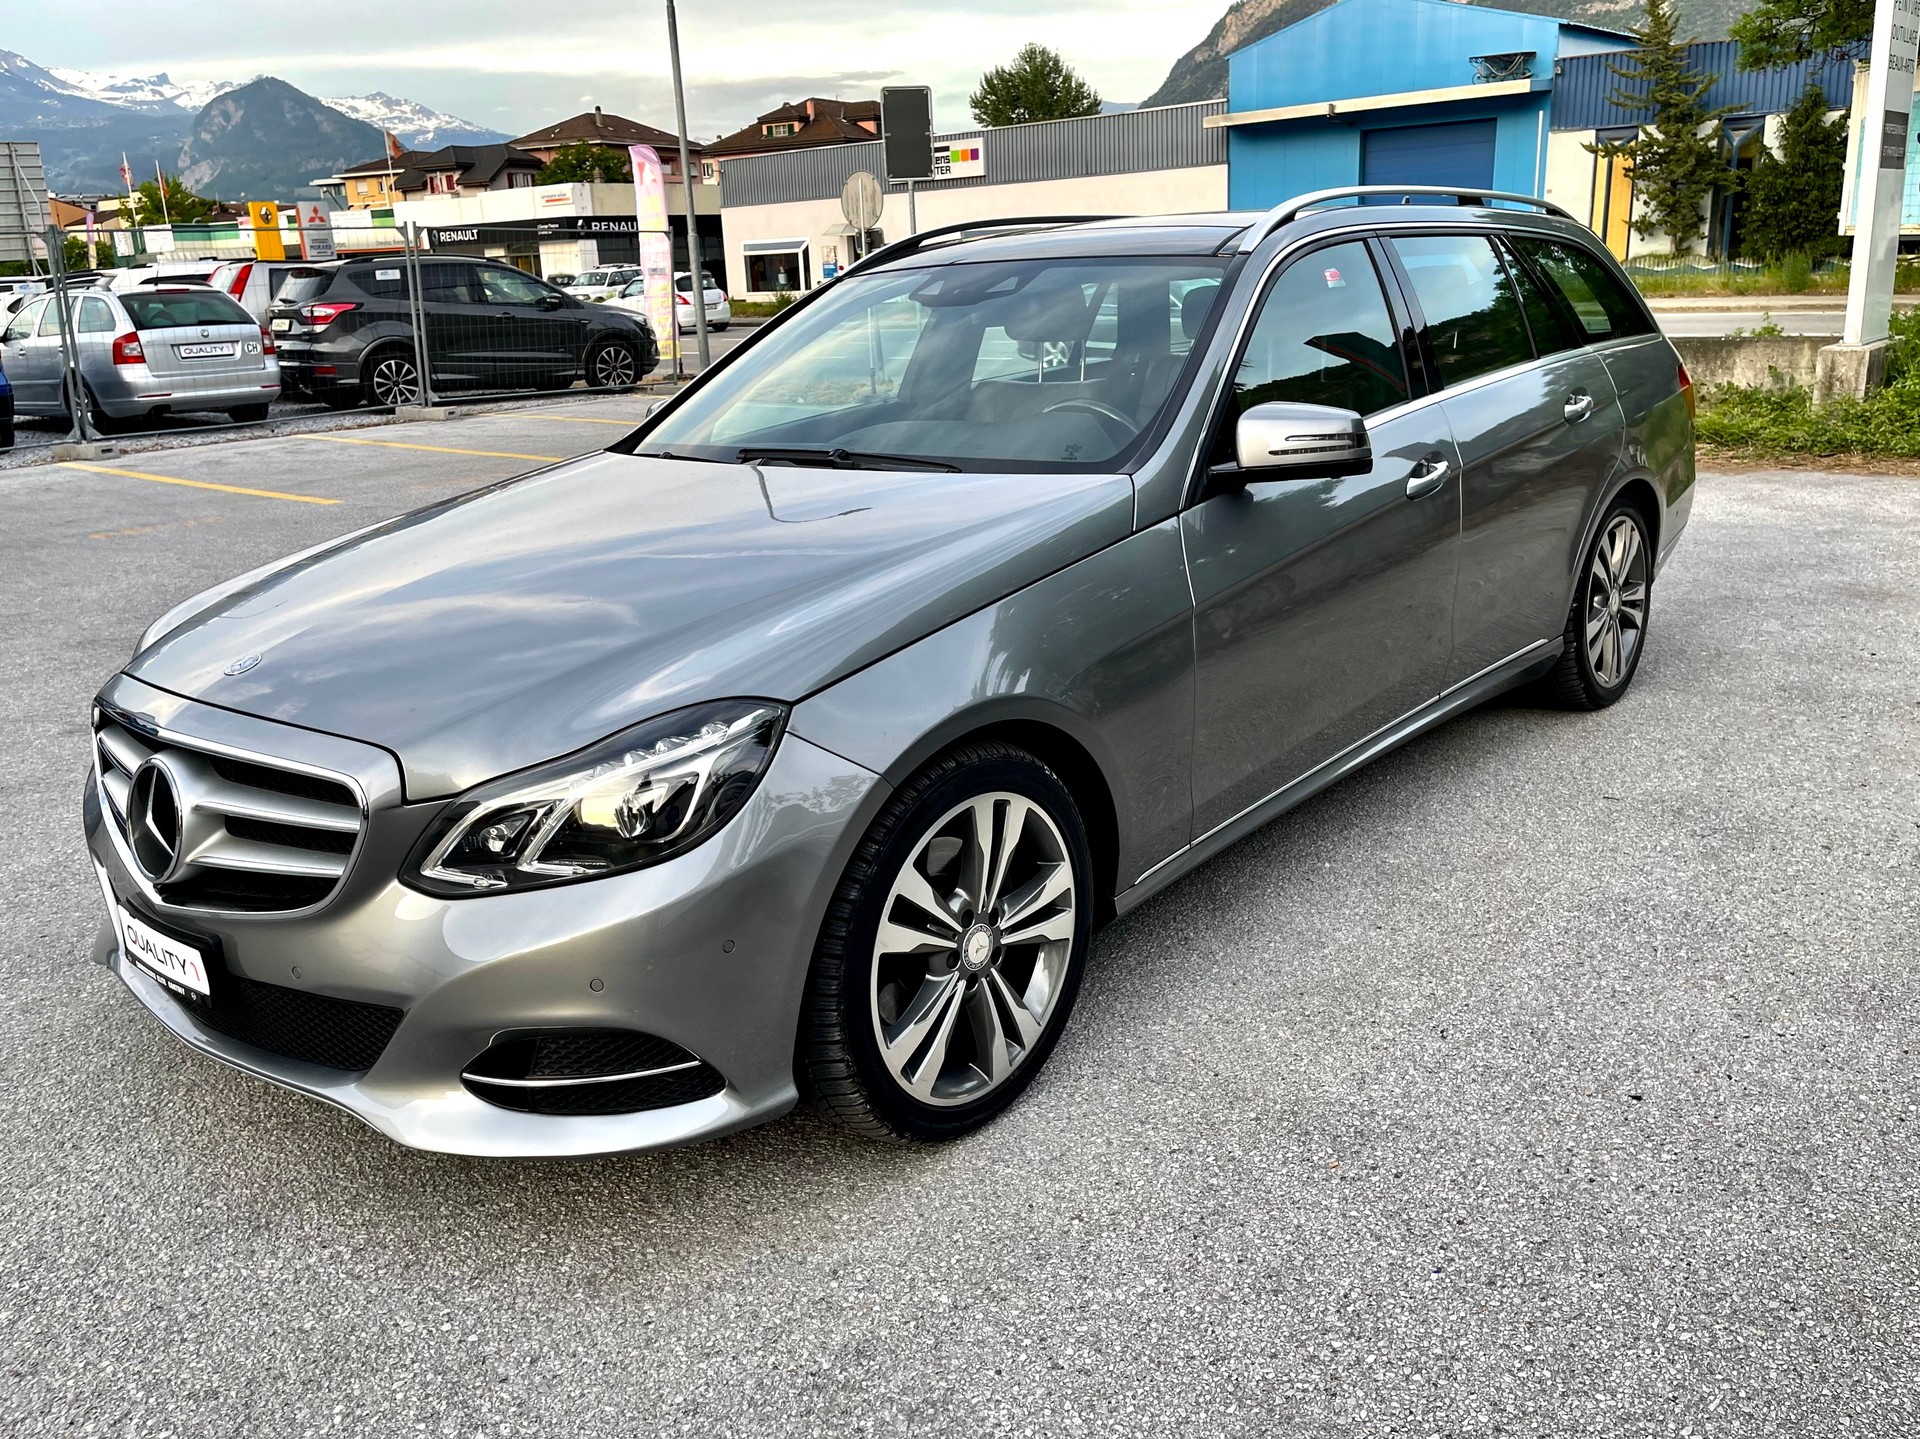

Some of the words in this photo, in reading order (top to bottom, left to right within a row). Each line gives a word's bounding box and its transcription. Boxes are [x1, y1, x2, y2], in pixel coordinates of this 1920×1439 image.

[1892, 24, 1918, 46] OUTILLAGE
[1889, 53, 1915, 75] BEAUX-ARTS
[935, 155, 950, 165] ens
[935, 165, 951, 175] TER
[591, 221, 637, 231] RENAU
[439, 229, 479, 242] RENAULT
[183, 346, 224, 355] QUALITY
[246, 343, 258, 353] CH
[127, 924, 186, 975] QUALITY
